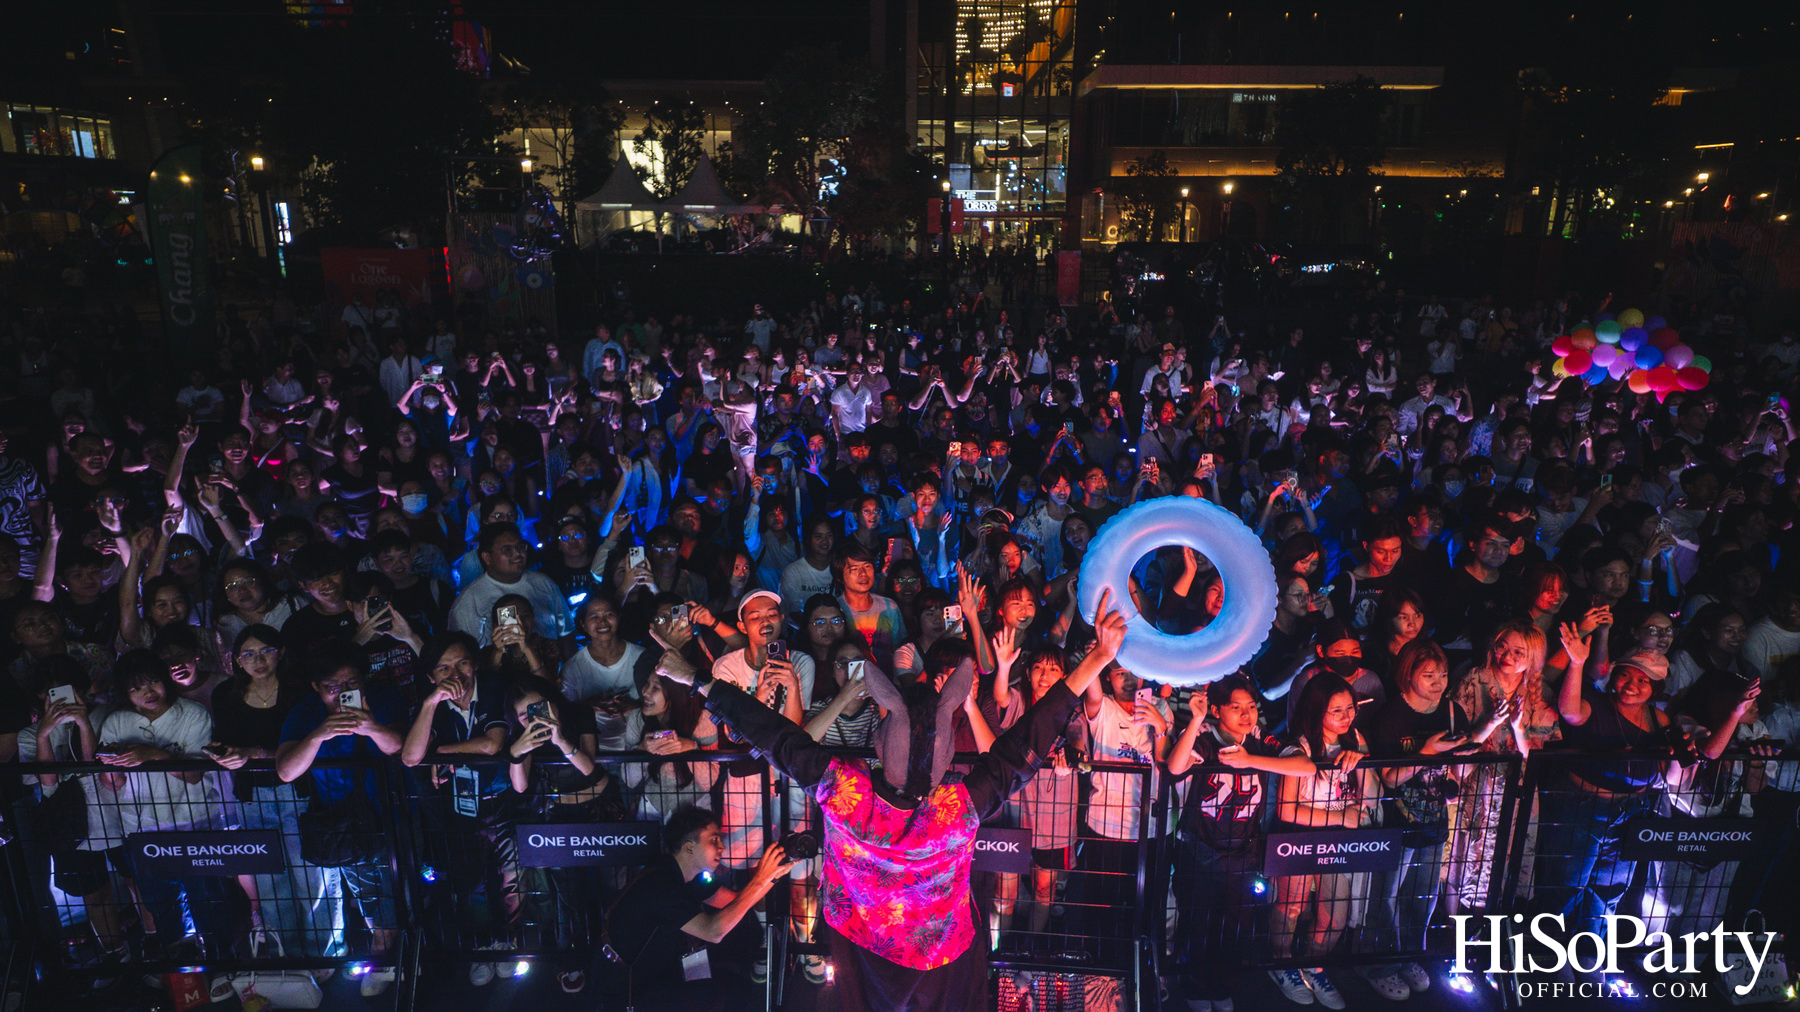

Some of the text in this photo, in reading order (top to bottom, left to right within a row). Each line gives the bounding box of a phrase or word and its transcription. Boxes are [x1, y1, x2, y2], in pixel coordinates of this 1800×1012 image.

[955, 190, 976, 200] THE
[964, 201, 998, 211] OREYS
[360, 262, 388, 274] One
[169, 232, 196, 326] Chang
[528, 833, 648, 848] ONE BANGKOK
[1638, 828, 1752, 843] ONE BANGKOK
[143, 843, 268, 858] ONE BANGKOK
[975, 840, 1020, 853] GKOK
[1276, 840, 1391, 857] ONE BANGKOK
[1677, 844, 1707, 852] RETAIL
[573, 849, 605, 857] RETAIL
[191, 858, 225, 867] RETAIL
[1317, 856, 1348, 865] RETAIL
